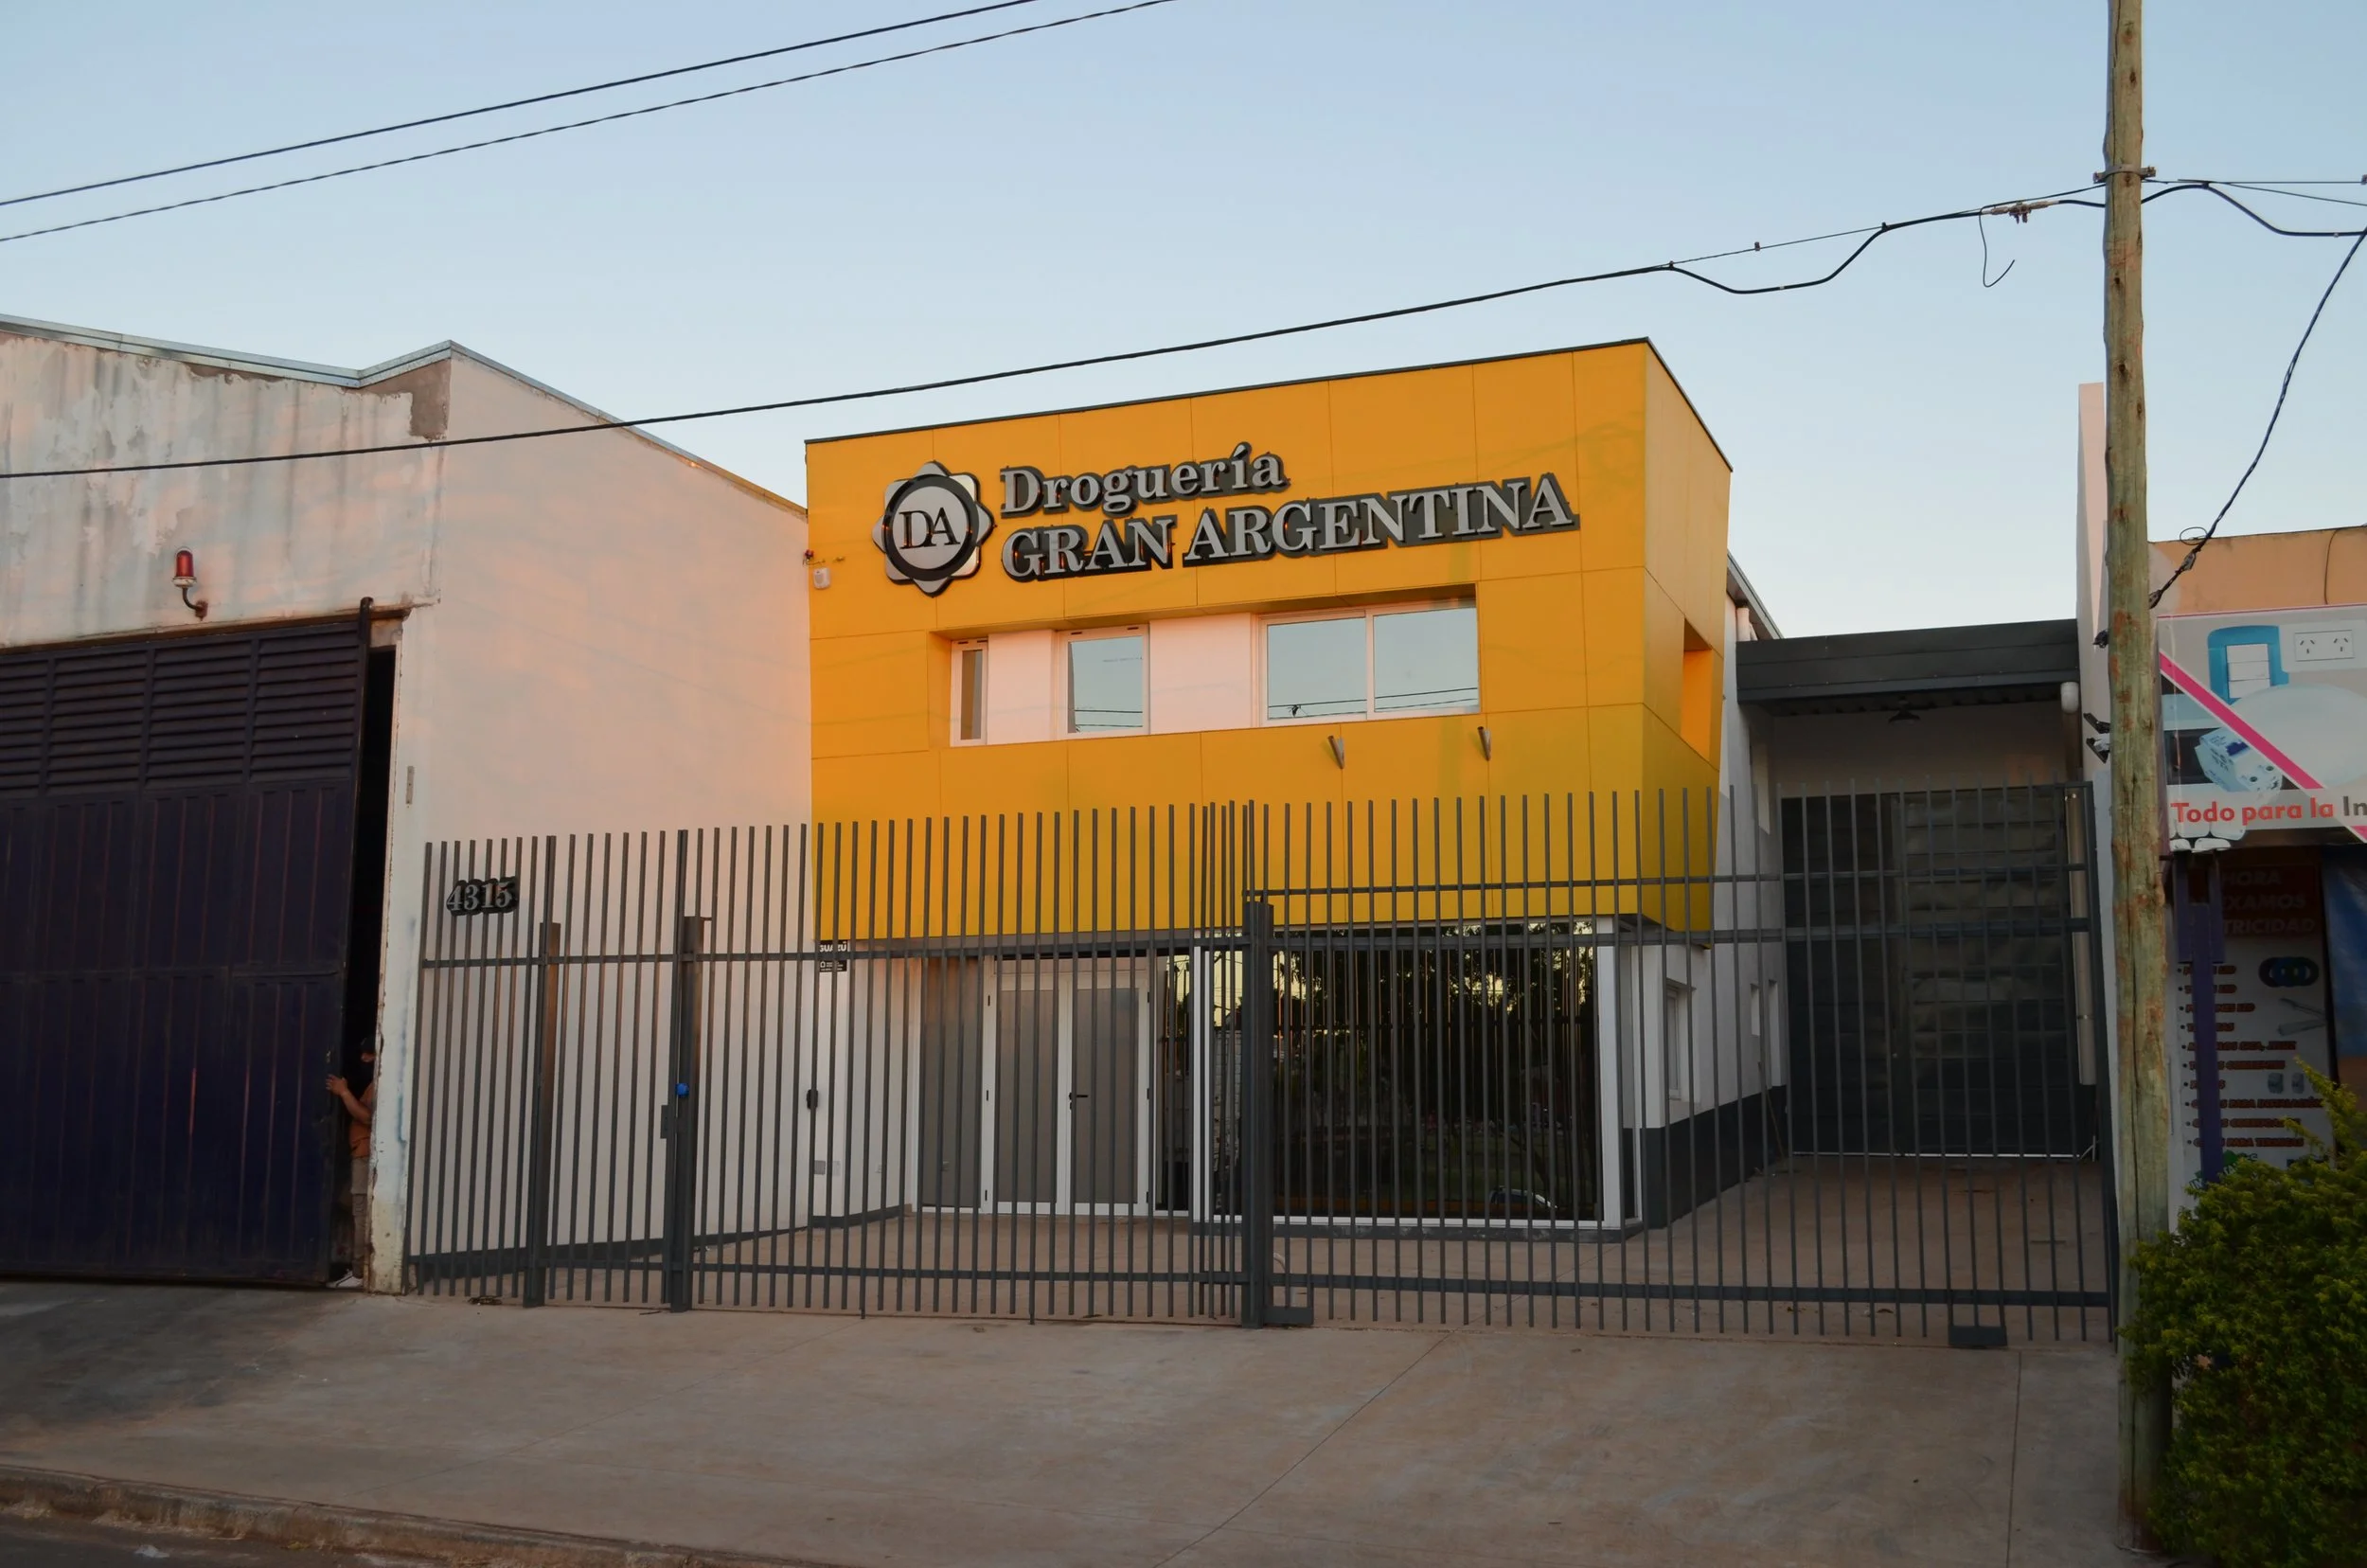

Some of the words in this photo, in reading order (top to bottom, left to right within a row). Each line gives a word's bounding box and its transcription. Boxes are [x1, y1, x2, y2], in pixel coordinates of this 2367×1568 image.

[1001, 443, 1285, 513] Droguería
[898, 506, 959, 551] DA
[1002, 515, 1175, 580] GRAN
[1184, 474, 1575, 564] ARGENTINA
[2170, 801, 2235, 823] Todo
[2241, 804, 2303, 826] para
[2310, 797, 2334, 818] la
[446, 881, 514, 912] 4315
[2221, 869, 2283, 886] HORA
